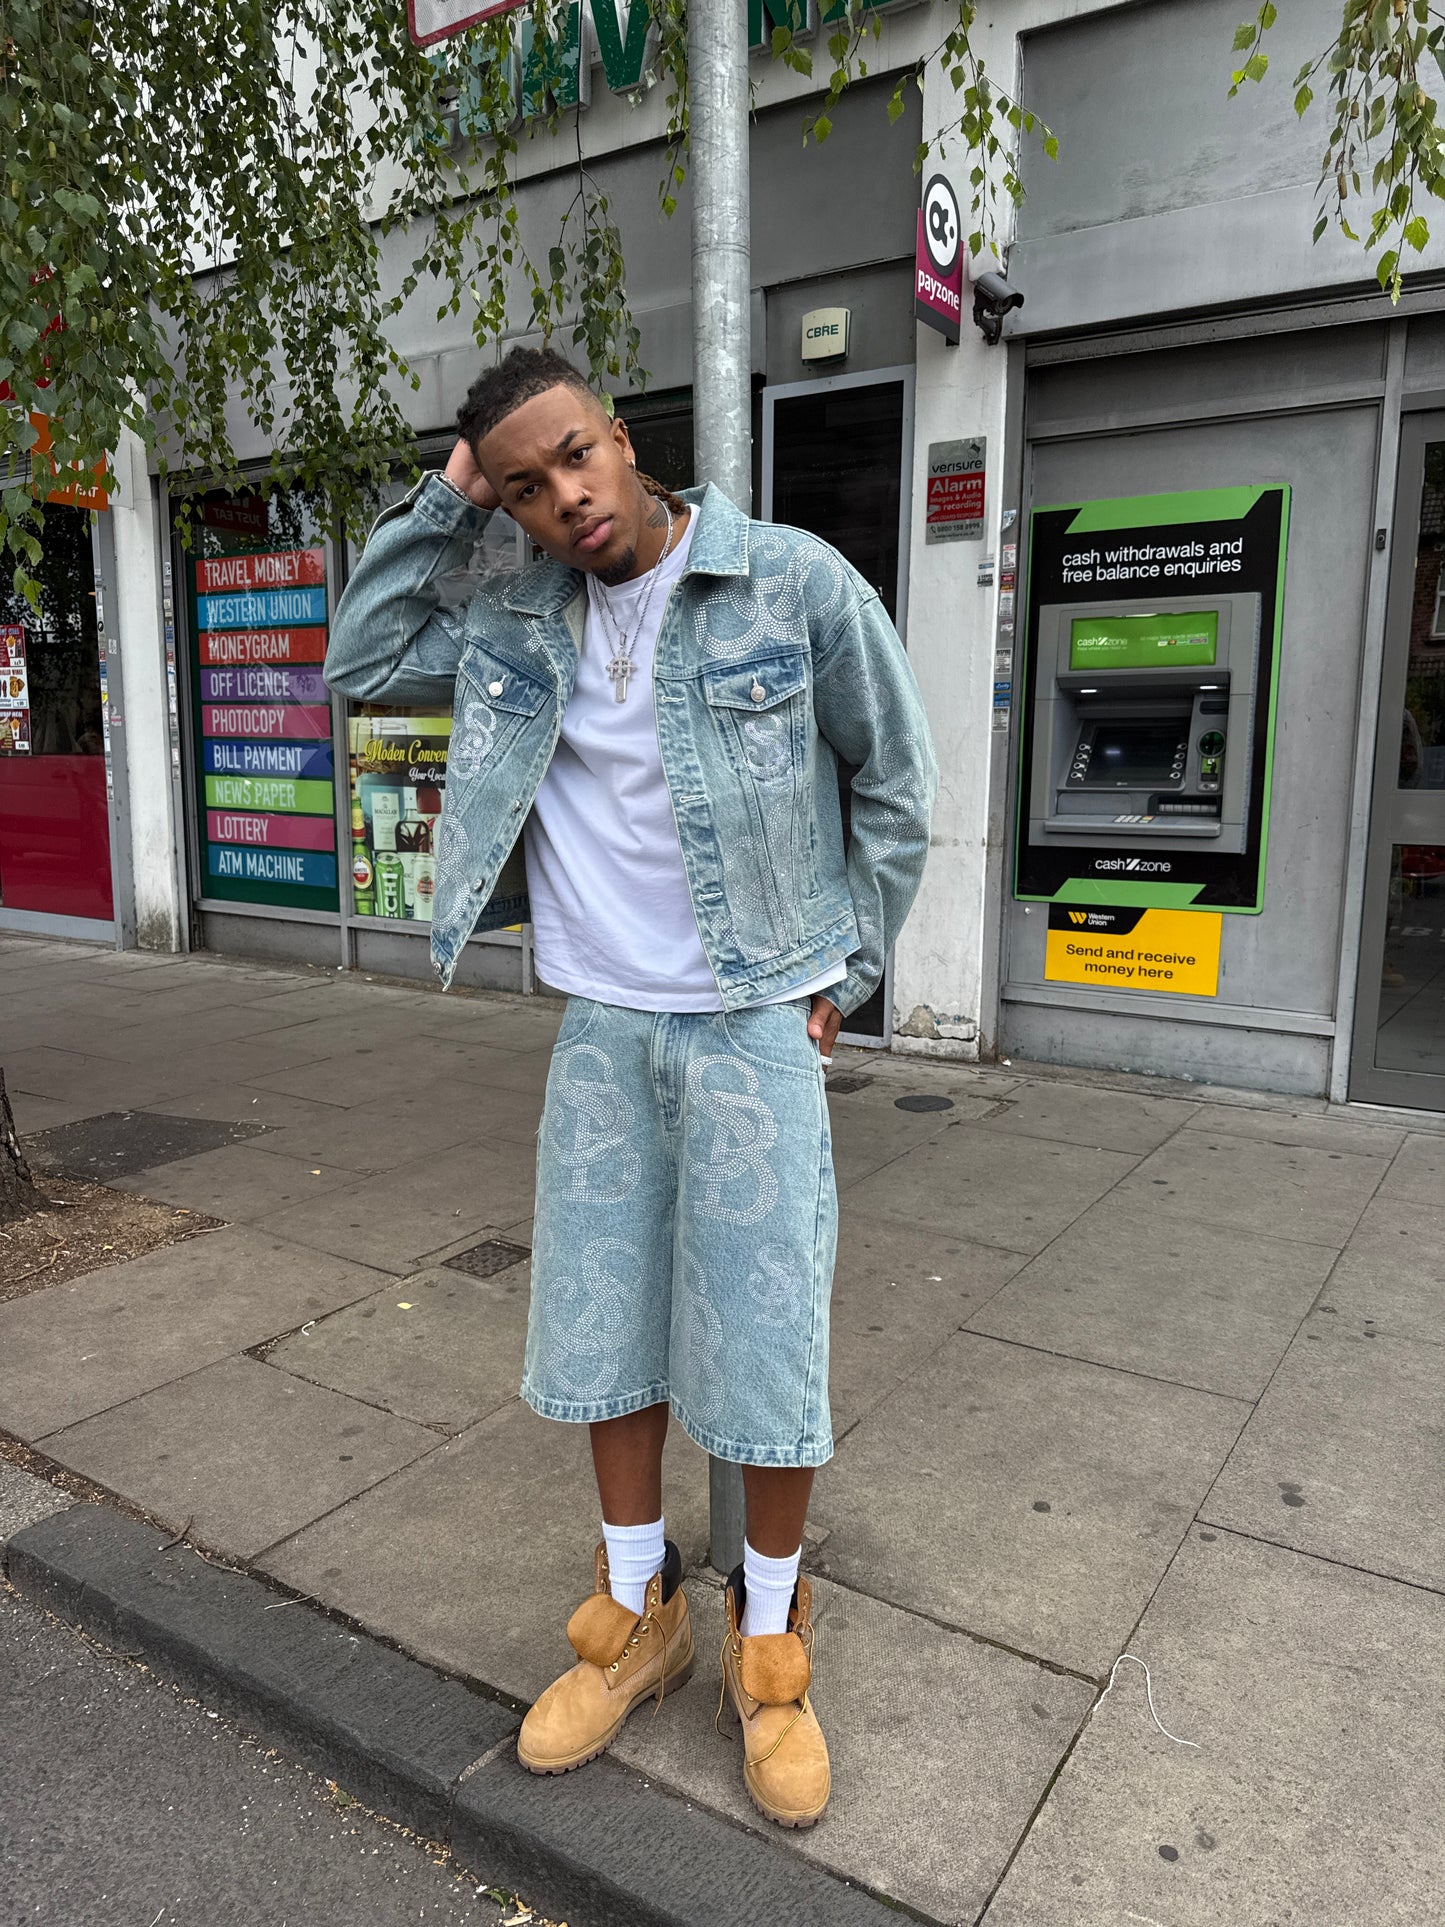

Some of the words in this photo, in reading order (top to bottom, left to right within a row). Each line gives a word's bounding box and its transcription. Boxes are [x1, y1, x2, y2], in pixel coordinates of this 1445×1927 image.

[918, 269, 960, 311] payzone
[806, 324, 839, 339] CBRE
[931, 460, 983, 473] verisure
[931, 478, 982, 494] Alarm
[943, 500, 982, 511] recording
[1062, 549, 1101, 567] cash
[1105, 541, 1205, 563] withdrawals
[1209, 537, 1243, 555] and
[205, 560, 252, 587] TRAVEL
[255, 555, 300, 583] MONEY
[1062, 567, 1093, 583] free
[1096, 564, 1160, 581] balance
[1163, 557, 1242, 578] enquiries
[207, 597, 266, 623] WESTERN
[270, 593, 312, 620] UNION
[208, 634, 290, 660] MONEYGRAM
[210, 672, 233, 697] OFF
[237, 672, 291, 696] LICENCE
[212, 709, 285, 733] PHOTOCOPY
[213, 745, 241, 769] BILL
[244, 745, 302, 771] PAYMENT
[215, 780, 251, 805] NEWS
[254, 782, 296, 808] PAPER
[217, 816, 268, 842] LOTTERY
[219, 850, 243, 875] ATM
[246, 853, 304, 881] MACHINE
[1088, 912, 1115, 921] Western
[1088, 919, 1108, 927] Union
[1066, 944, 1103, 957] Send
[1106, 949, 1134, 960] and
[1137, 953, 1196, 965] receive
[1084, 962, 1135, 978] money
[1138, 966, 1174, 979] here
